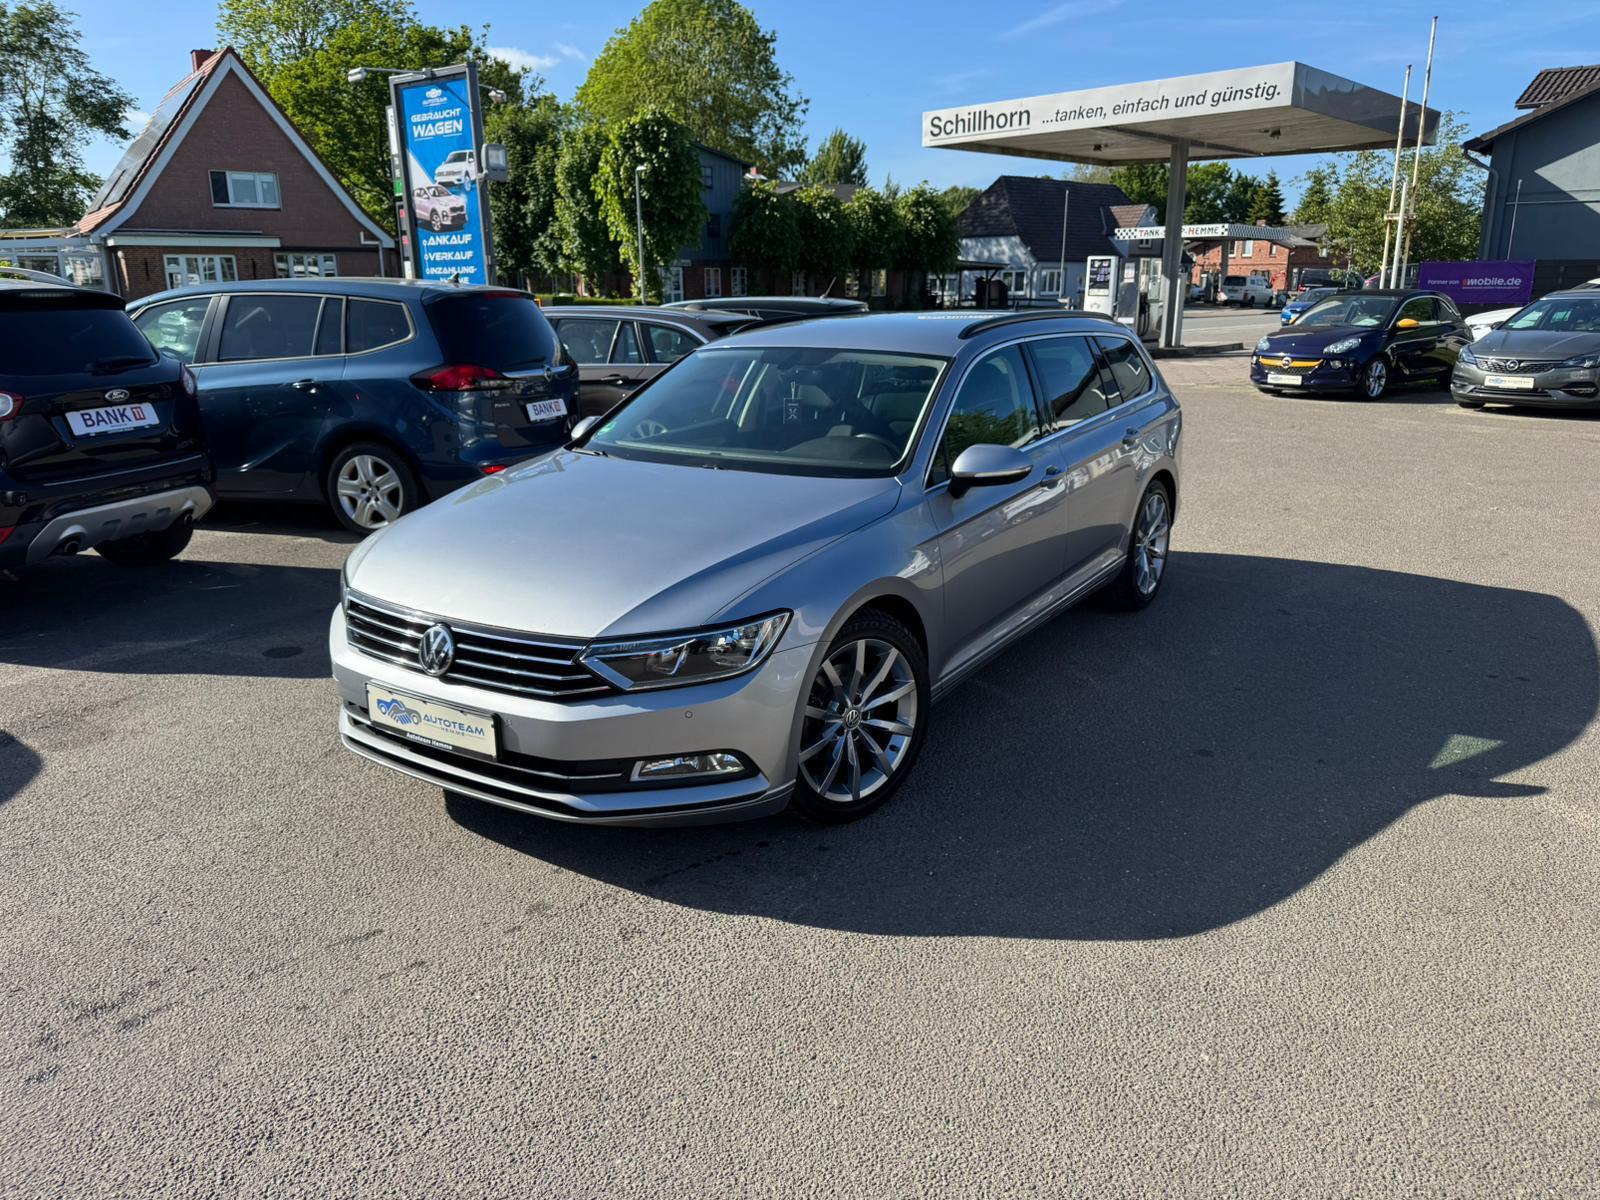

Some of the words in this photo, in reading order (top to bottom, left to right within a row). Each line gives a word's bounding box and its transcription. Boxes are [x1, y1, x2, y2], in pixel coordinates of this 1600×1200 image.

[411, 108, 462, 123] GEBRAUCHT
[929, 105, 1031, 138] Schillhorn
[1041, 105, 1107, 125] ...tanken,
[1112, 94, 1169, 116] einfach
[1174, 91, 1206, 110] und
[1210, 82, 1281, 108] günstig.
[412, 119, 463, 138] WAGEN
[427, 233, 473, 246] ANKAUF
[428, 250, 474, 261] VERKAUF
[532, 400, 555, 416] BANK
[80, 407, 132, 428] BANK
[423, 714, 485, 737] AUTOTEAM
[406, 732, 432, 745] Autoteam
[432, 739, 453, 750] Hemme
